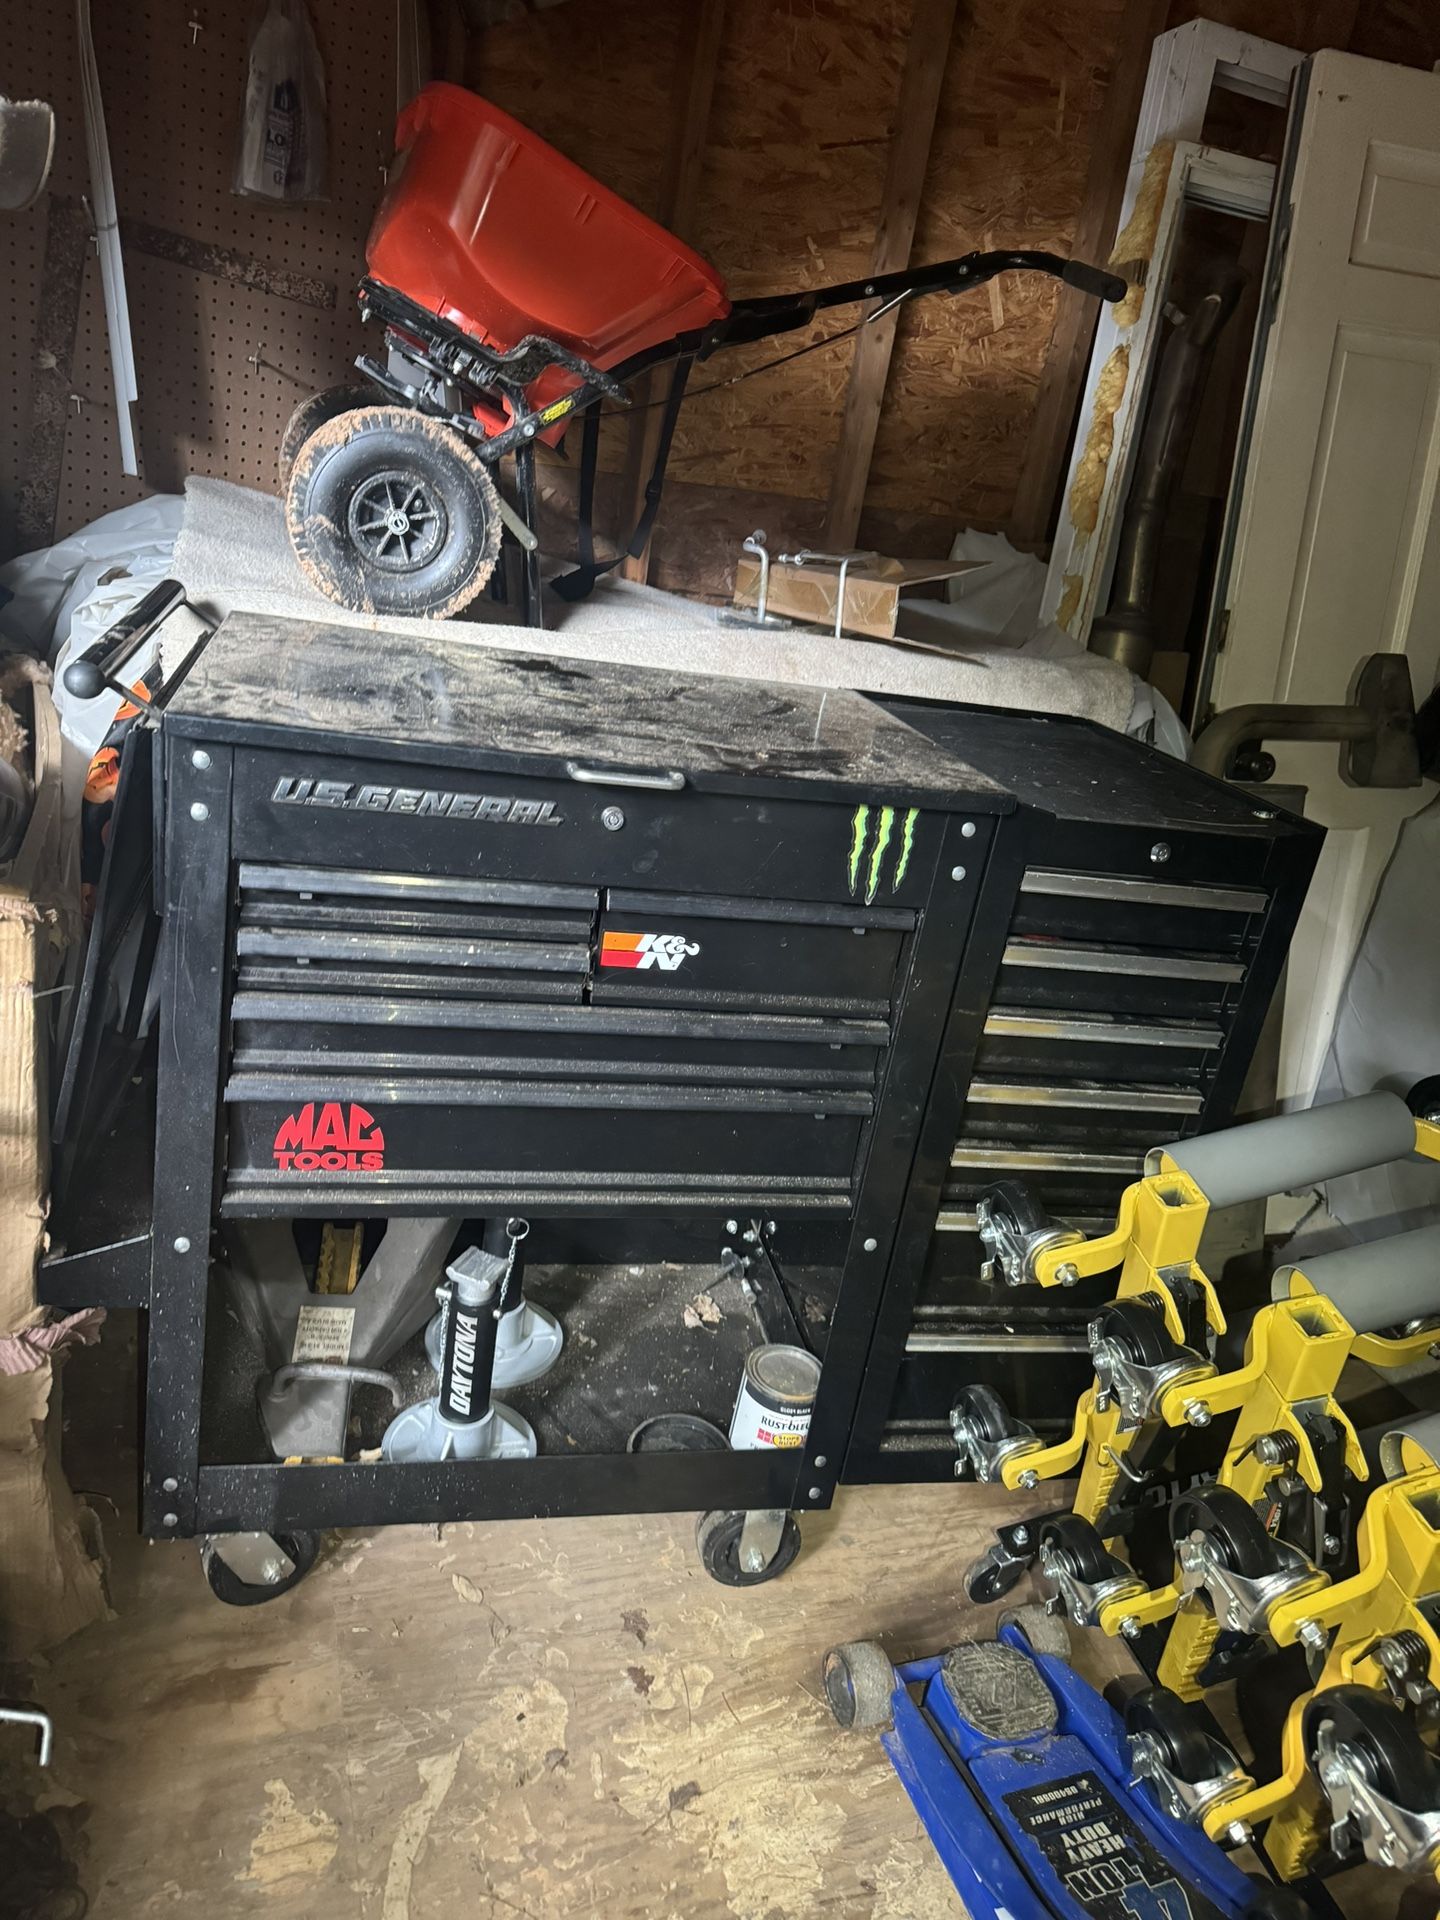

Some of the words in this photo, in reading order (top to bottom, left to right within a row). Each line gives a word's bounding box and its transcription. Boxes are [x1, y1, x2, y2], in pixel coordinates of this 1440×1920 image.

[635, 933, 700, 971] K&N
[273, 1102, 385, 1151] MAC
[273, 1151, 384, 1171] TOOLS
[449, 1311, 478, 1416] DAYTONA
[1030, 1797, 1103, 1826] PERFORMANCE
[1058, 1810, 1085, 1826] HIGH
[1060, 1821, 1111, 1848] DUTY
[1066, 1834, 1127, 1864] HEAVY
[1064, 1856, 1143, 1901] TON
